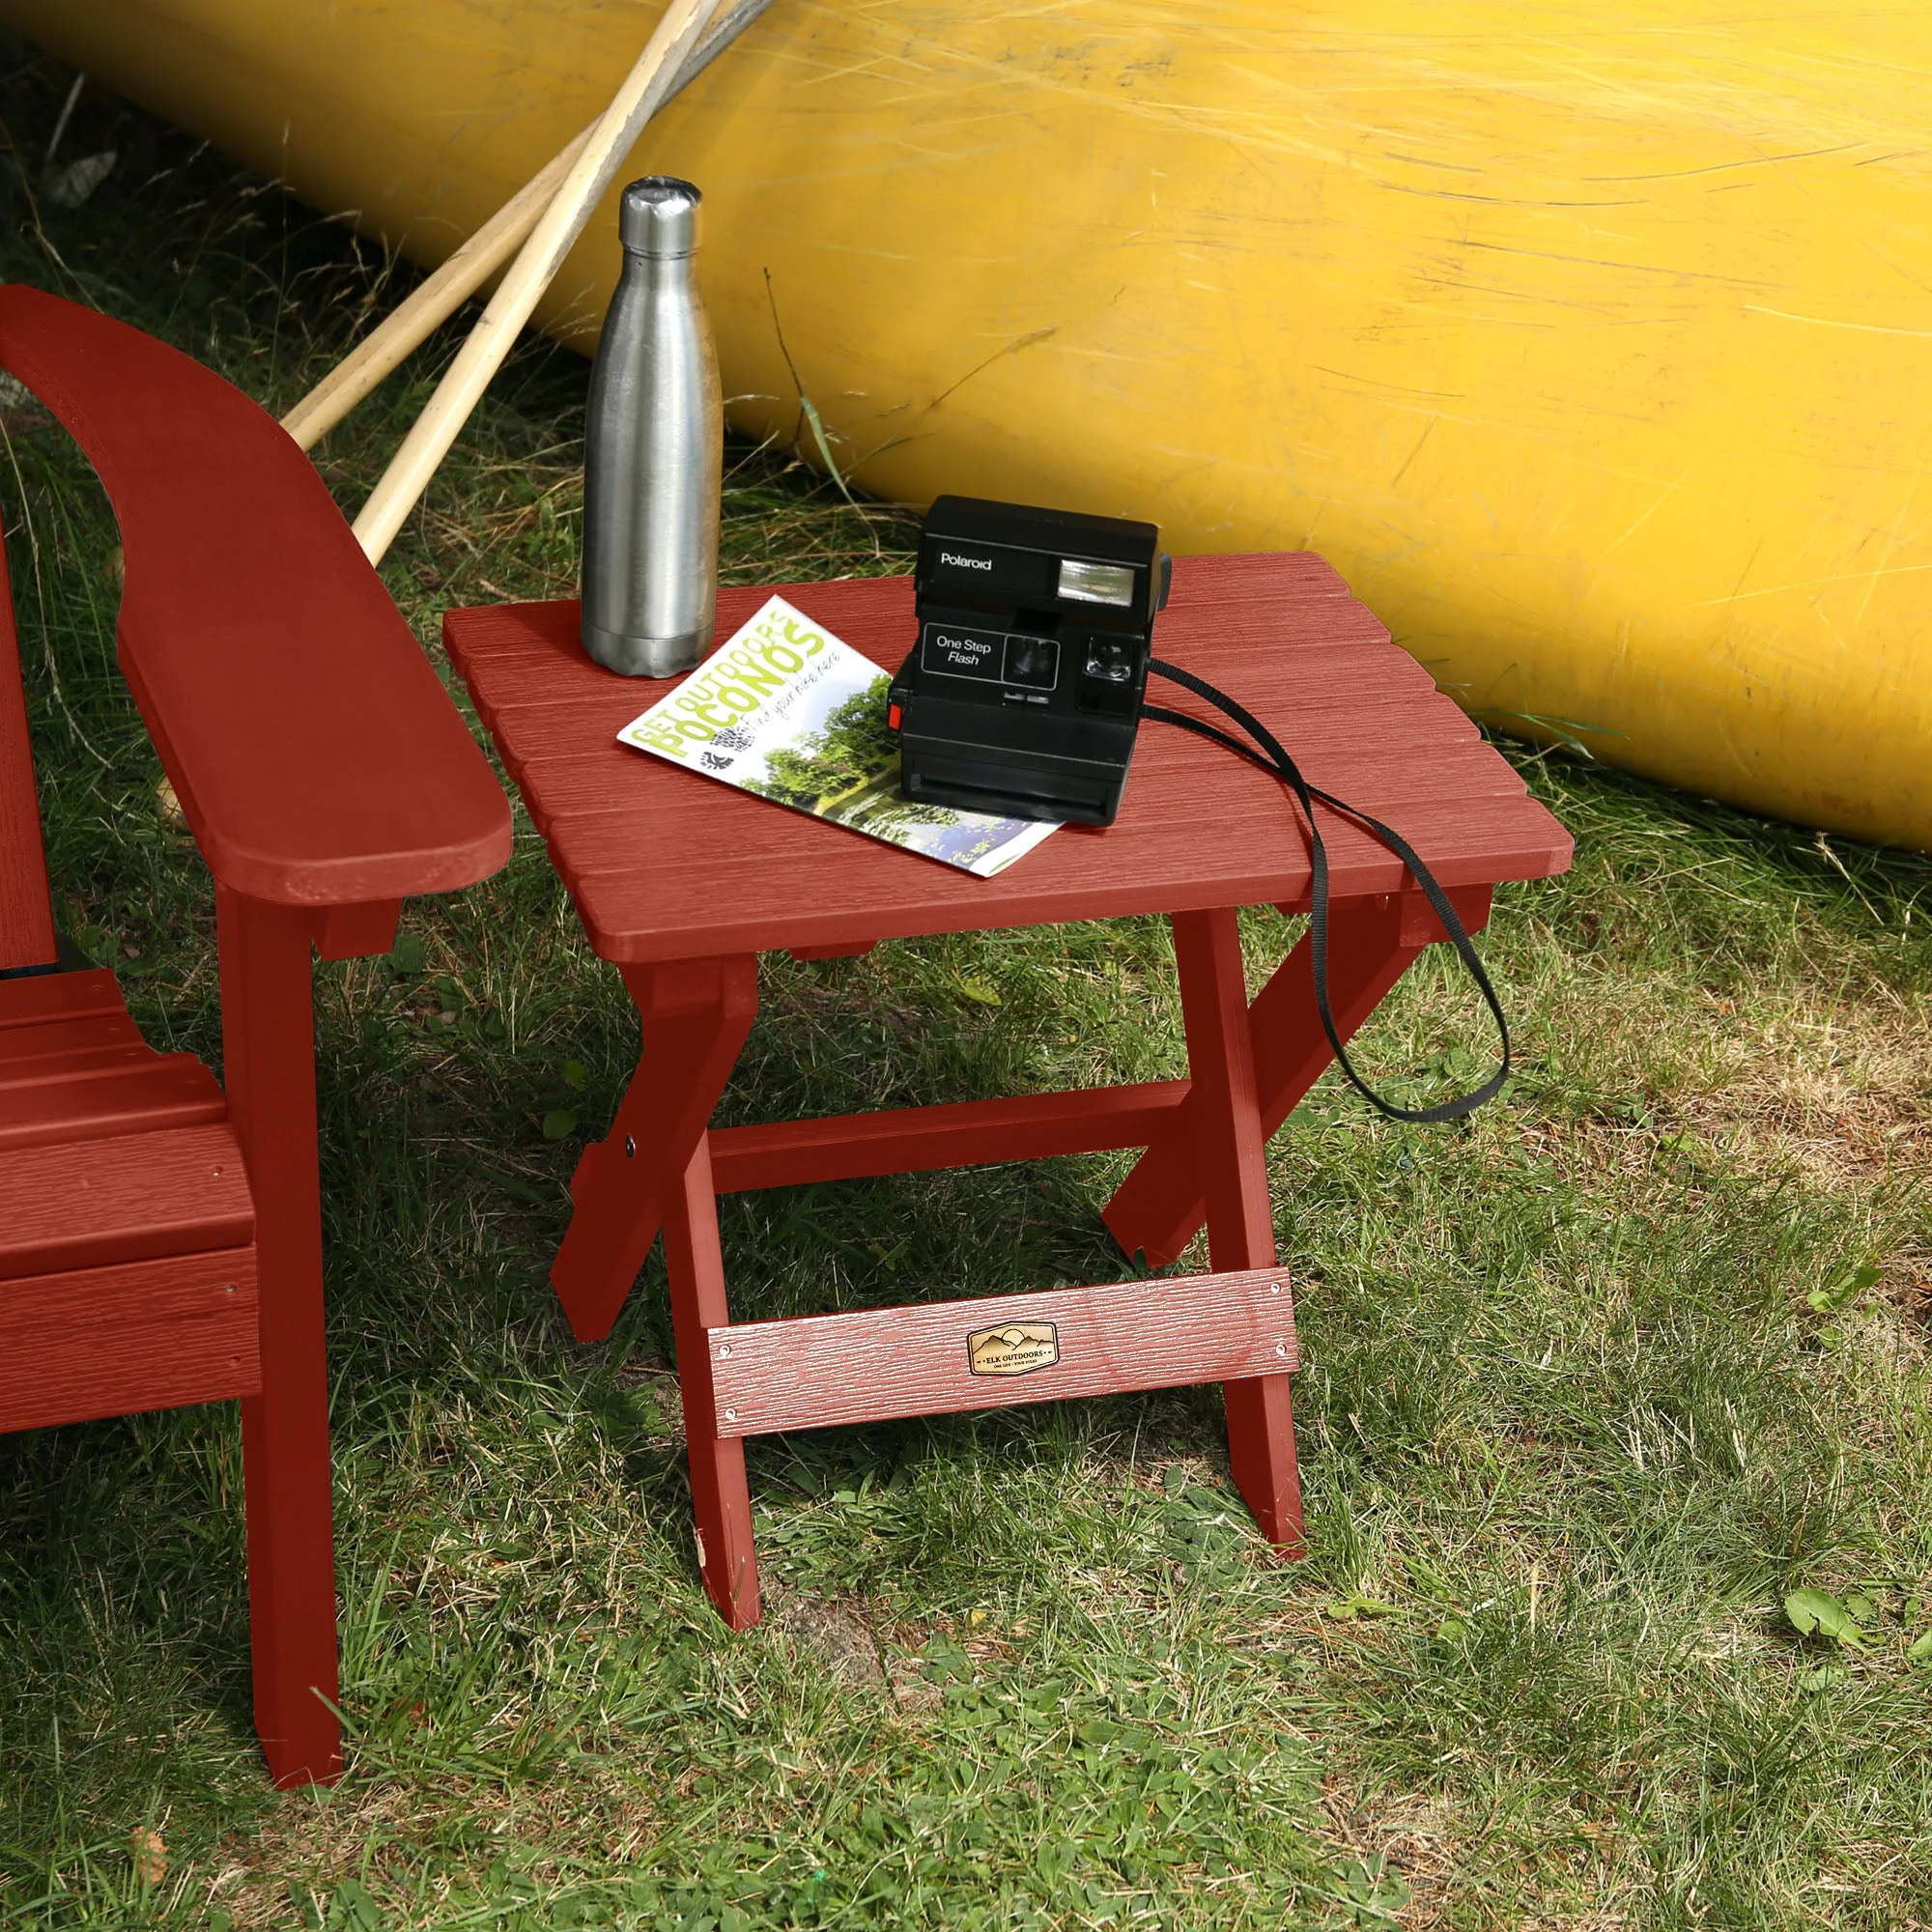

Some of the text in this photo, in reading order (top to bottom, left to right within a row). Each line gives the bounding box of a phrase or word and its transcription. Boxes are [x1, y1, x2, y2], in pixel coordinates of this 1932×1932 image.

[941, 553, 992, 571] Polaroid
[936, 635, 991, 655] One Step
[948, 651, 980, 666] Flash
[631, 610, 787, 743] GET OUTDOORS
[648, 618, 825, 758] POCONOS
[772, 692, 794, 721] your
[785, 669, 818, 695] hike
[1002, 1350, 1043, 1361] OUTDOORS
